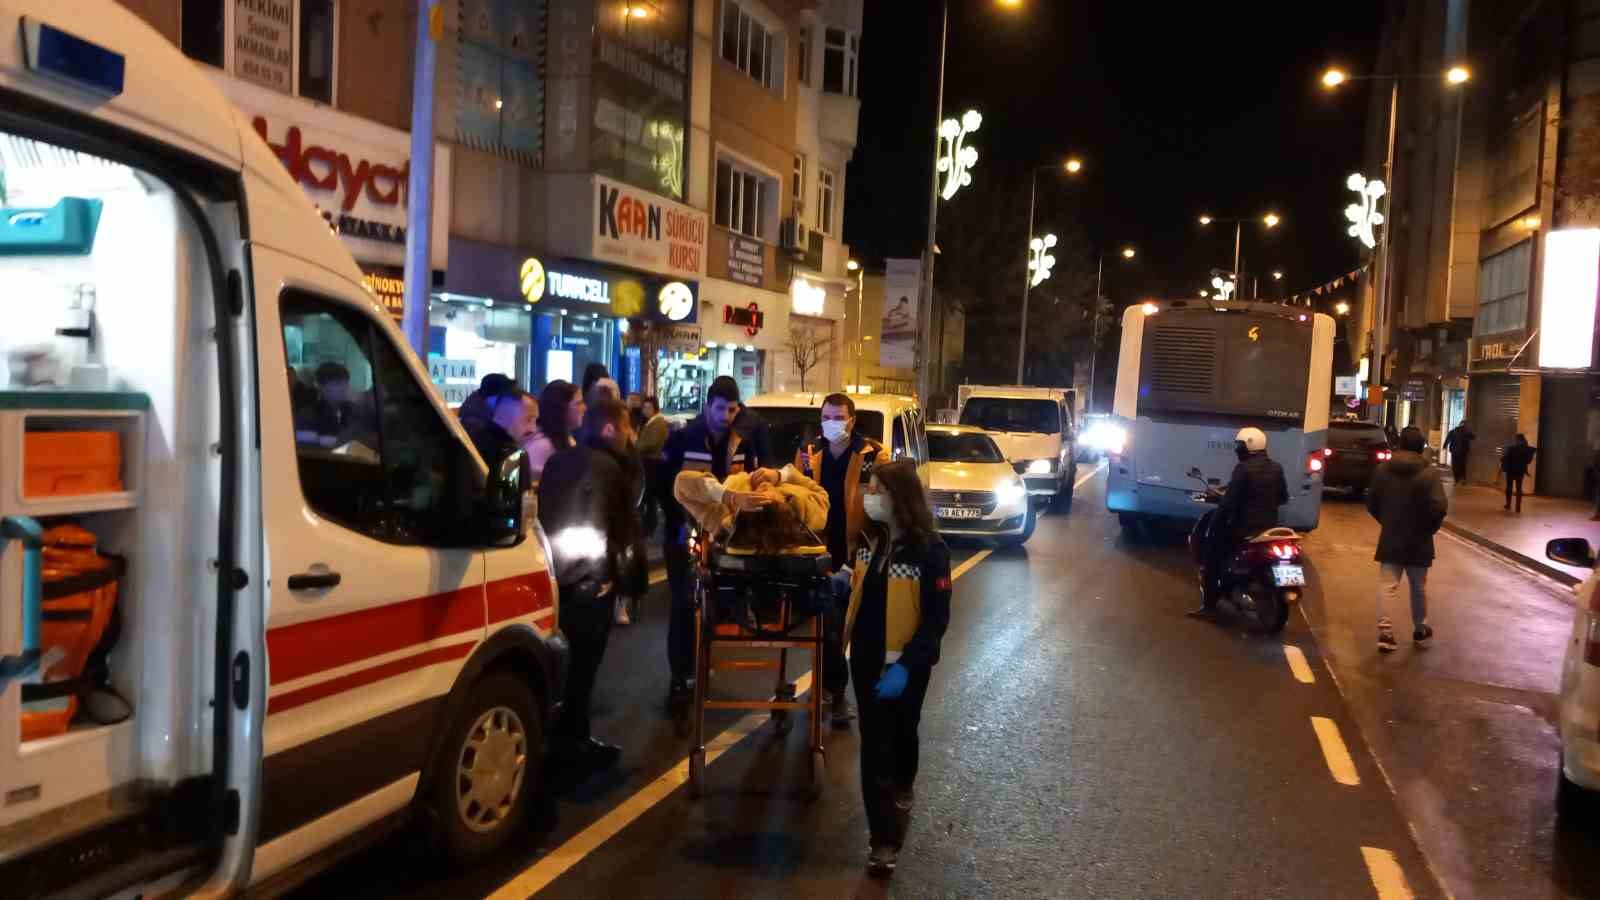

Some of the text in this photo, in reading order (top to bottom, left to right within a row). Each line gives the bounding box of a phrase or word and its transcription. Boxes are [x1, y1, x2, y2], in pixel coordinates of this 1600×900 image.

[600, 184, 661, 241] KAAN
[669, 243, 700, 273] KURSU
[548, 271, 611, 305] TURKCELL
